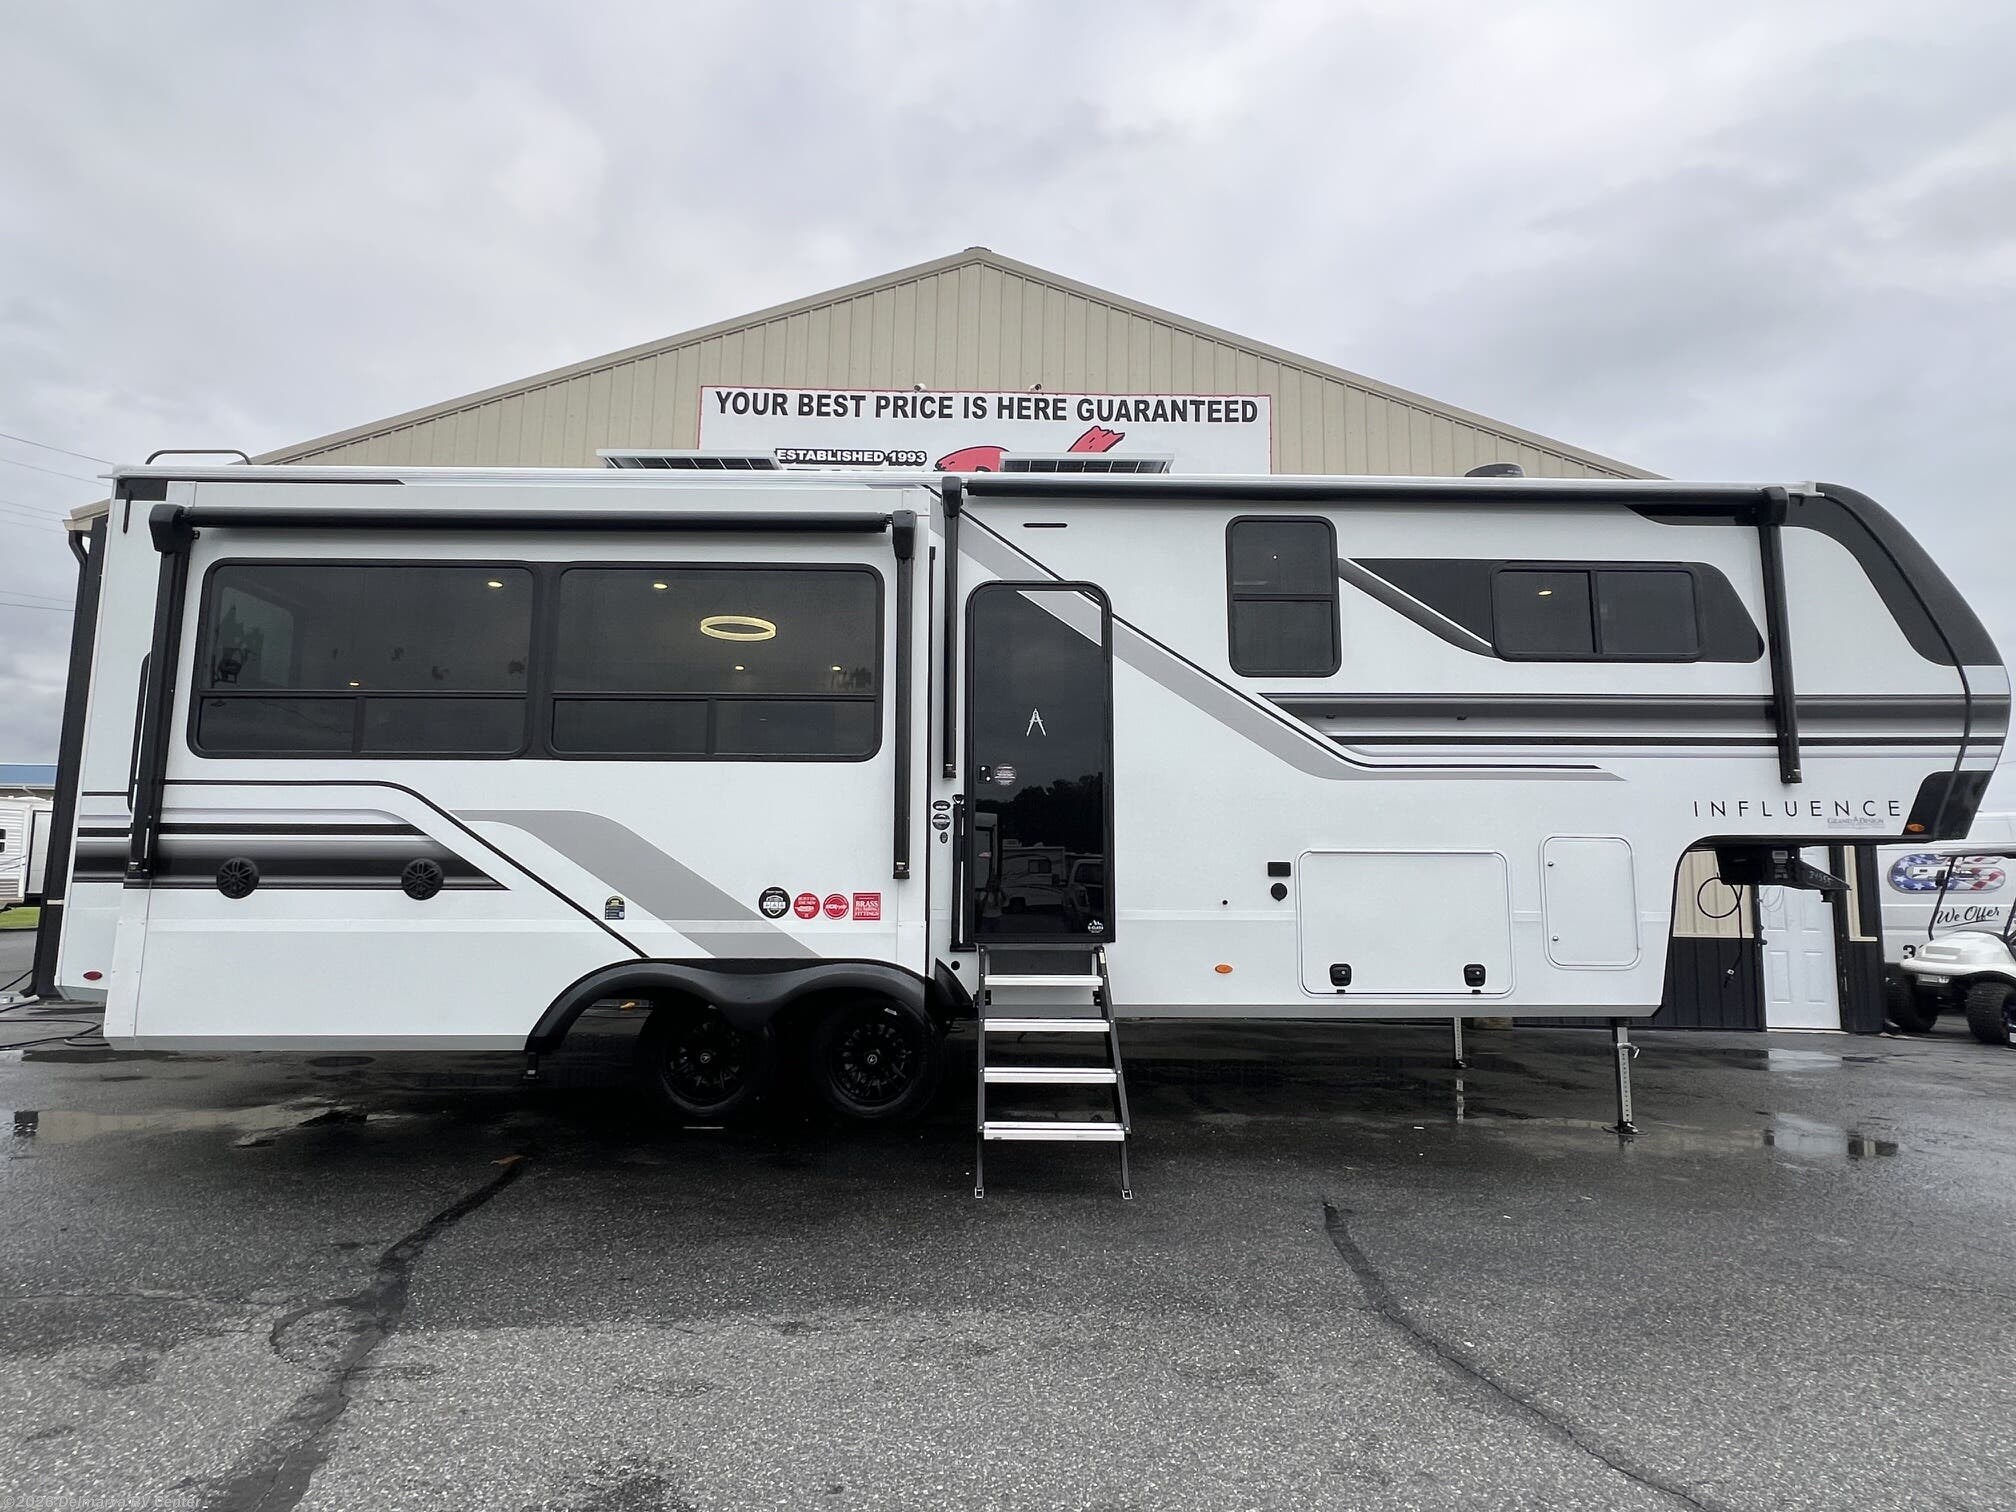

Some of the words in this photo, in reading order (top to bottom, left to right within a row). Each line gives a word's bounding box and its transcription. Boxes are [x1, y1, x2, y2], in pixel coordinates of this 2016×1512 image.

[716, 391, 788, 416] YOUR
[798, 393, 866, 418] BEST
[875, 395, 953, 419] PRICE
[963, 396, 987, 419] IS
[997, 397, 1067, 421] HERE
[1077, 398, 1258, 423] GUARANTEED
[776, 449, 885, 463] ESTABLISHED
[888, 451, 926, 463] 1993
[1694, 800, 1901, 817] INFLUENCE
[855, 900, 879, 908] BRASS
[1936, 907, 1960, 924] We
[1964, 905, 2000, 921] Offer
